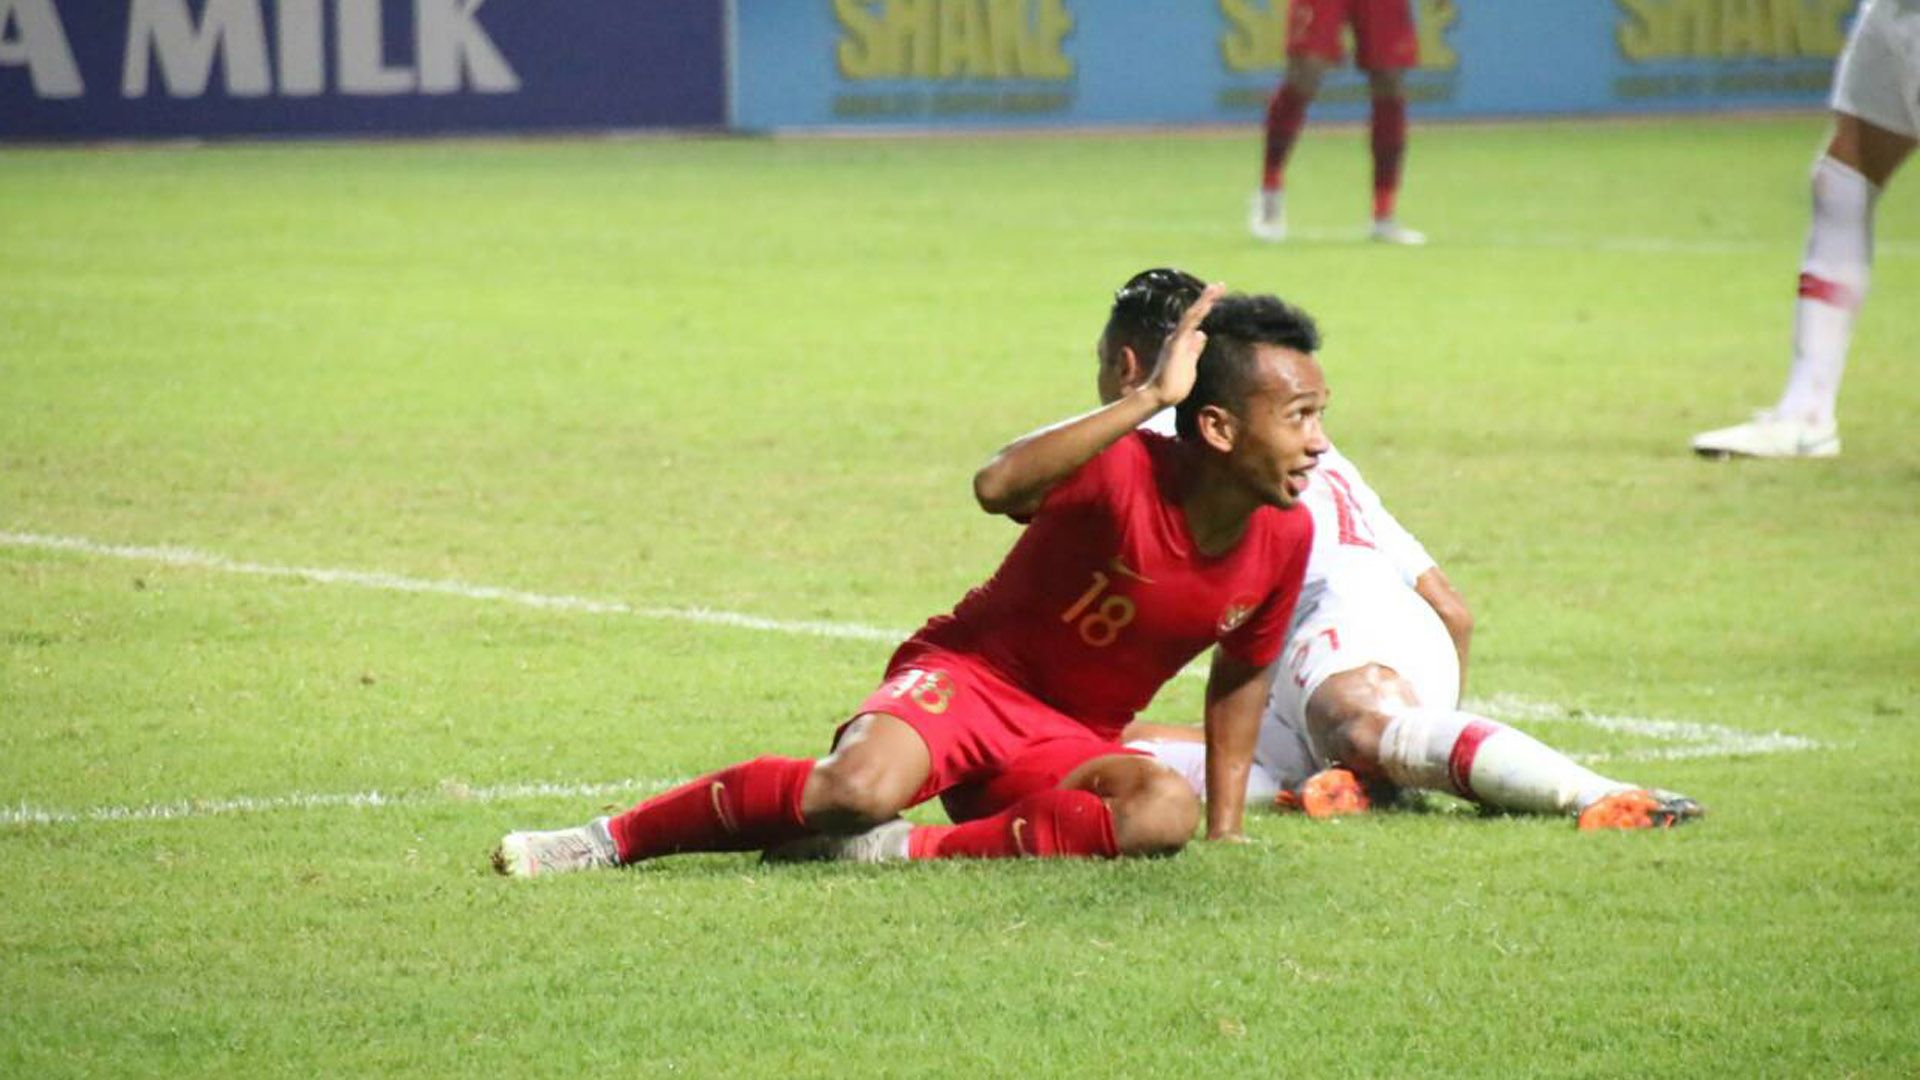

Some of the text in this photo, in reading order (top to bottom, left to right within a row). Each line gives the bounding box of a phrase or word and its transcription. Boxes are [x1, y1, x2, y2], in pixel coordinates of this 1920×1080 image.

[122, 0, 522, 97] MILK
[1061, 570, 1136, 647] 18
[890, 668, 955, 715] 18
